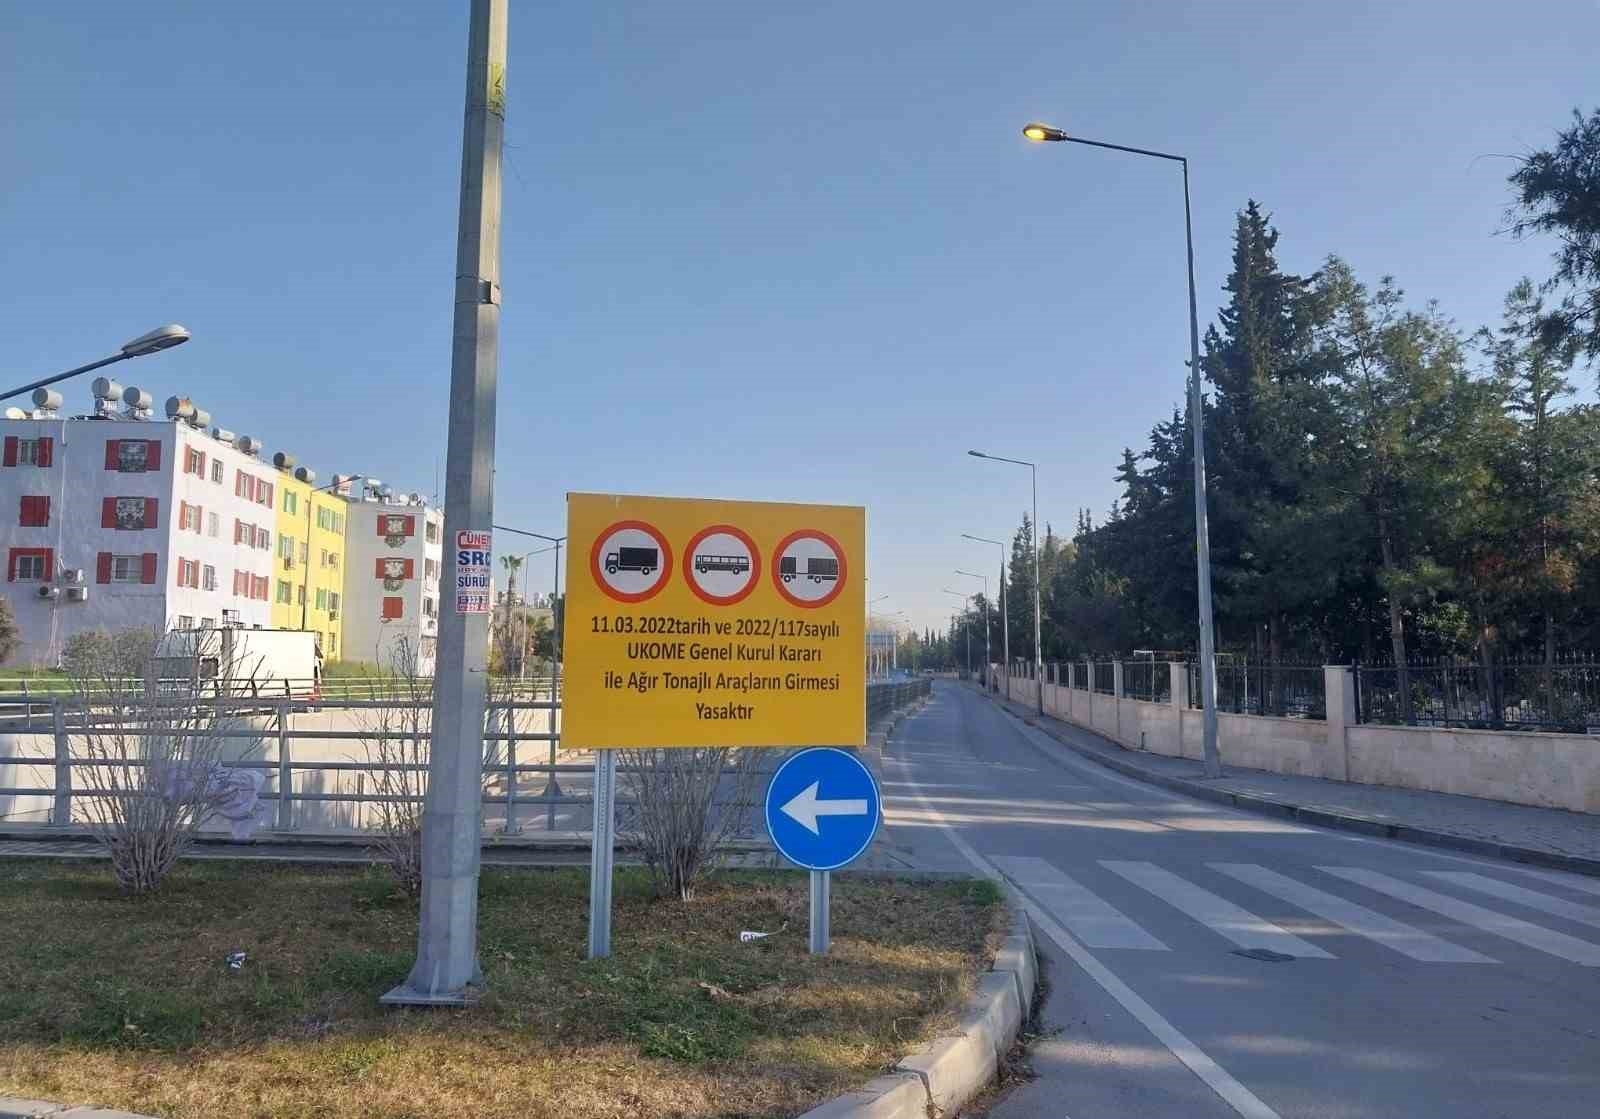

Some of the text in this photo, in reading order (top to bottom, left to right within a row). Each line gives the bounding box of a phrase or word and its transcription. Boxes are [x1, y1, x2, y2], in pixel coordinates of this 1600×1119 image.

[458, 574, 489, 588] SÜRÜ
[592, 616, 840, 640] 11.03.2022tarih ve 2022/117sayılı
[627, 642, 822, 661] UKOME Genel Kurul Kararı
[604, 670, 840, 693] ile Ağır Tonajlı Araçların Girmesi
[696, 701, 754, 720] Yasaktır
